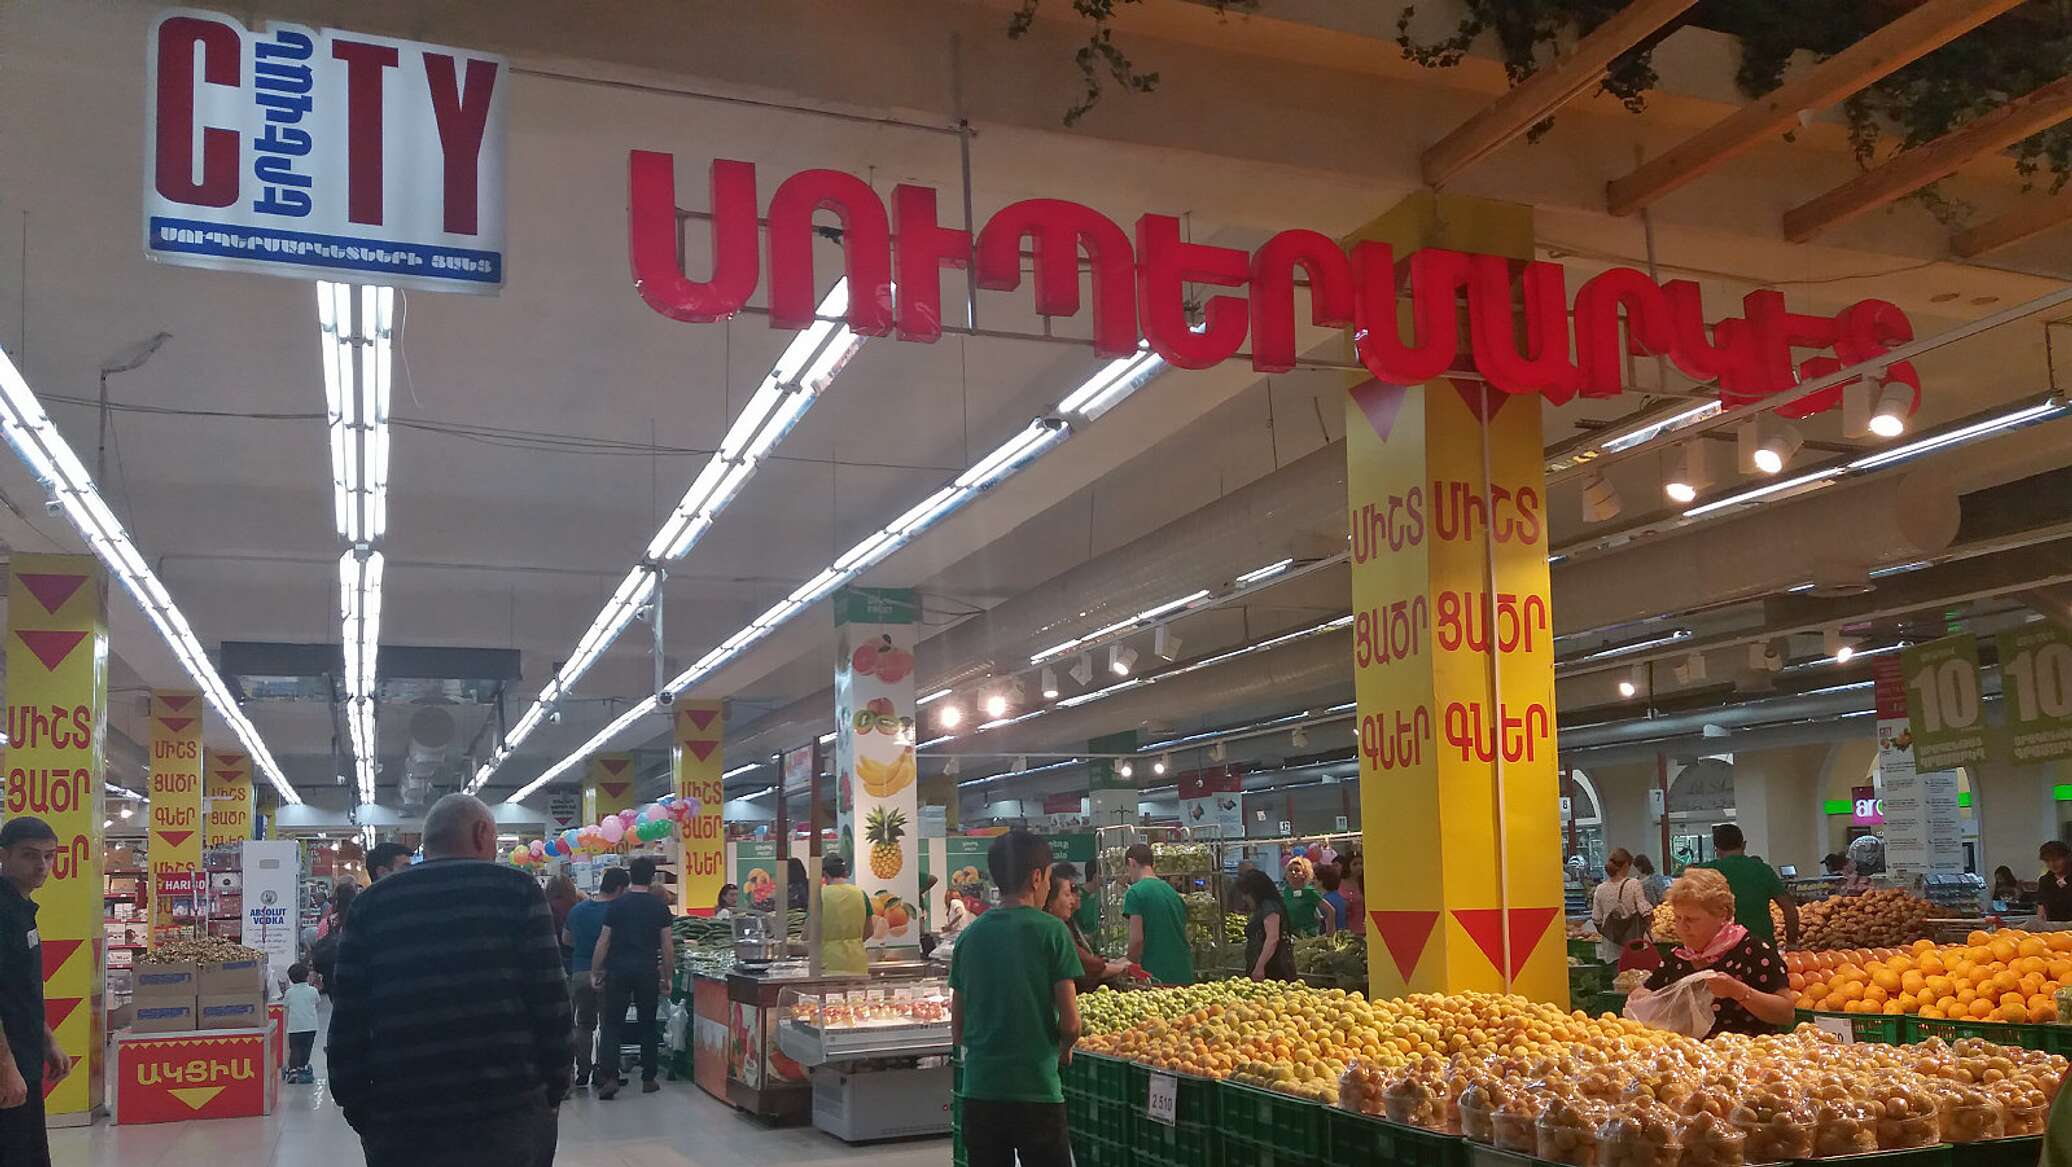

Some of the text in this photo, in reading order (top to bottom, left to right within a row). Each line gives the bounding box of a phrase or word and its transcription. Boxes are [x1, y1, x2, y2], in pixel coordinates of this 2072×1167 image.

[1353, 486, 1425, 564] ՄԻՇՏ
[1434, 481, 1540, 546] ՄԻՇՏ
[1356, 594, 1428, 669] ՑԱԾՐ
[1437, 591, 1546, 656] ՑԱԾՐ
[1910, 658, 1979, 733] 10
[2005, 643, 2072, 722] 10
[8, 705, 91, 750] ՄԻՇՏ
[154, 740, 197, 759] ՄԻՇՏ
[1361, 705, 1430, 771] ԳՆԵՐ
[1445, 702, 1548, 763] ԳՆԵՐ
[7, 768, 91, 815] ՑԱԾՐ
[154, 773, 197, 793] ՑԱԾՐ
[154, 807, 195, 826] ԳՆԵՐ
[211, 811, 246, 826] ՑԱԾՐ
[50, 834, 90, 880] ԵՐ
[165, 881, 206, 892] HARIO
[137, 1058, 256, 1086] ԱԿՑԻԱ
